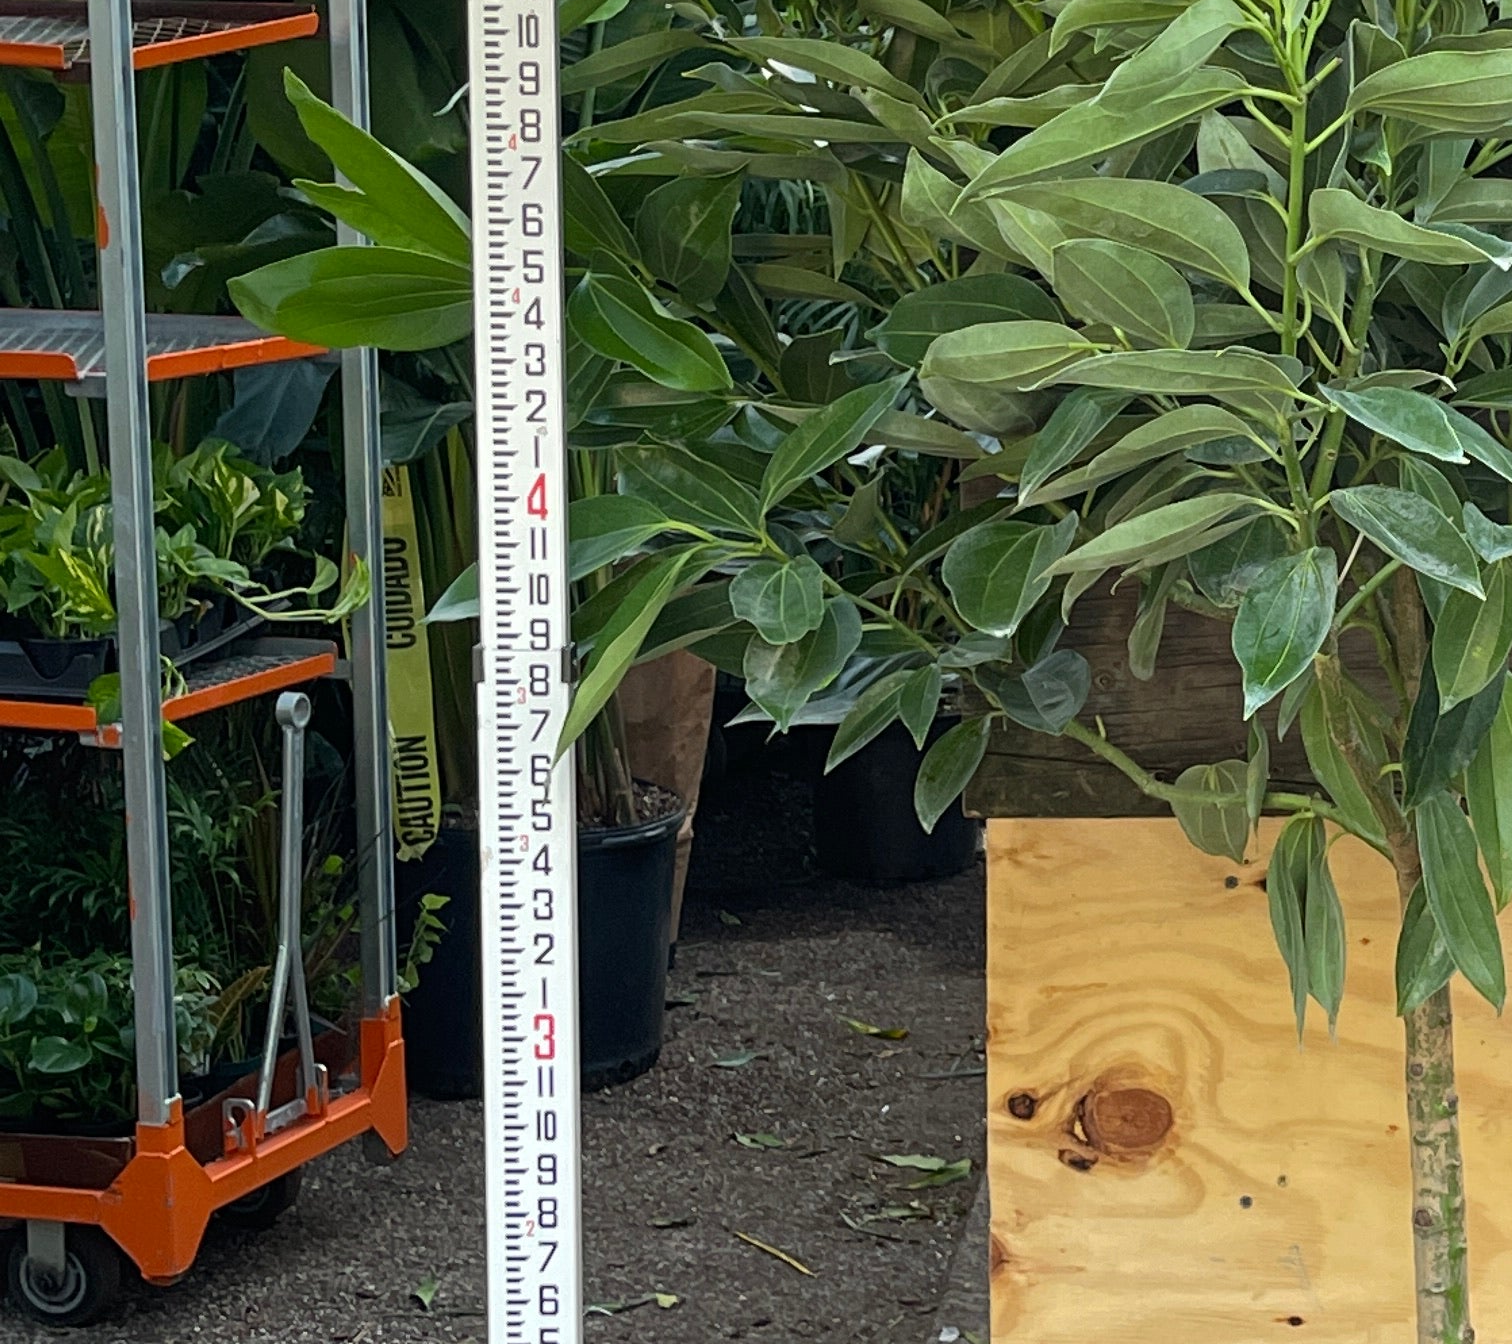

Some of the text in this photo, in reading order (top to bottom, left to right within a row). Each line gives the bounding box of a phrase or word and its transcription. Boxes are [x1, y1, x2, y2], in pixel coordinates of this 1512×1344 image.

[517, 13, 540, 49] 10
[518, 60, 541, 96] 9
[519, 108, 542, 143] 8
[520, 155, 543, 191] 7
[521, 202, 544, 238] 6
[522, 249, 545, 284] 5
[523, 296, 546, 331] 4
[523, 342, 547, 377] 3
[525, 389, 547, 423] 2
[526, 472, 549, 521] 4
[529, 526, 548, 561] 11
[528, 572, 551, 606] 10
[529, 617, 551, 652] 9
[528, 663, 551, 697] 8
[529, 708, 551, 743] 7
[394, 735, 436, 847] CAUTION
[531, 799, 553, 832] 5
[531, 843, 553, 877] 4
[532, 888, 554, 921] 3
[532, 932, 555, 966] 2
[533, 1013, 556, 1061] 3
[537, 1065, 555, 1098] 11
[535, 1109, 558, 1142] 10
[536, 1152, 558, 1186] 9
[536, 1196, 559, 1230] 8
[537, 1240, 559, 1274] 7
[538, 1284, 560, 1317] 6
